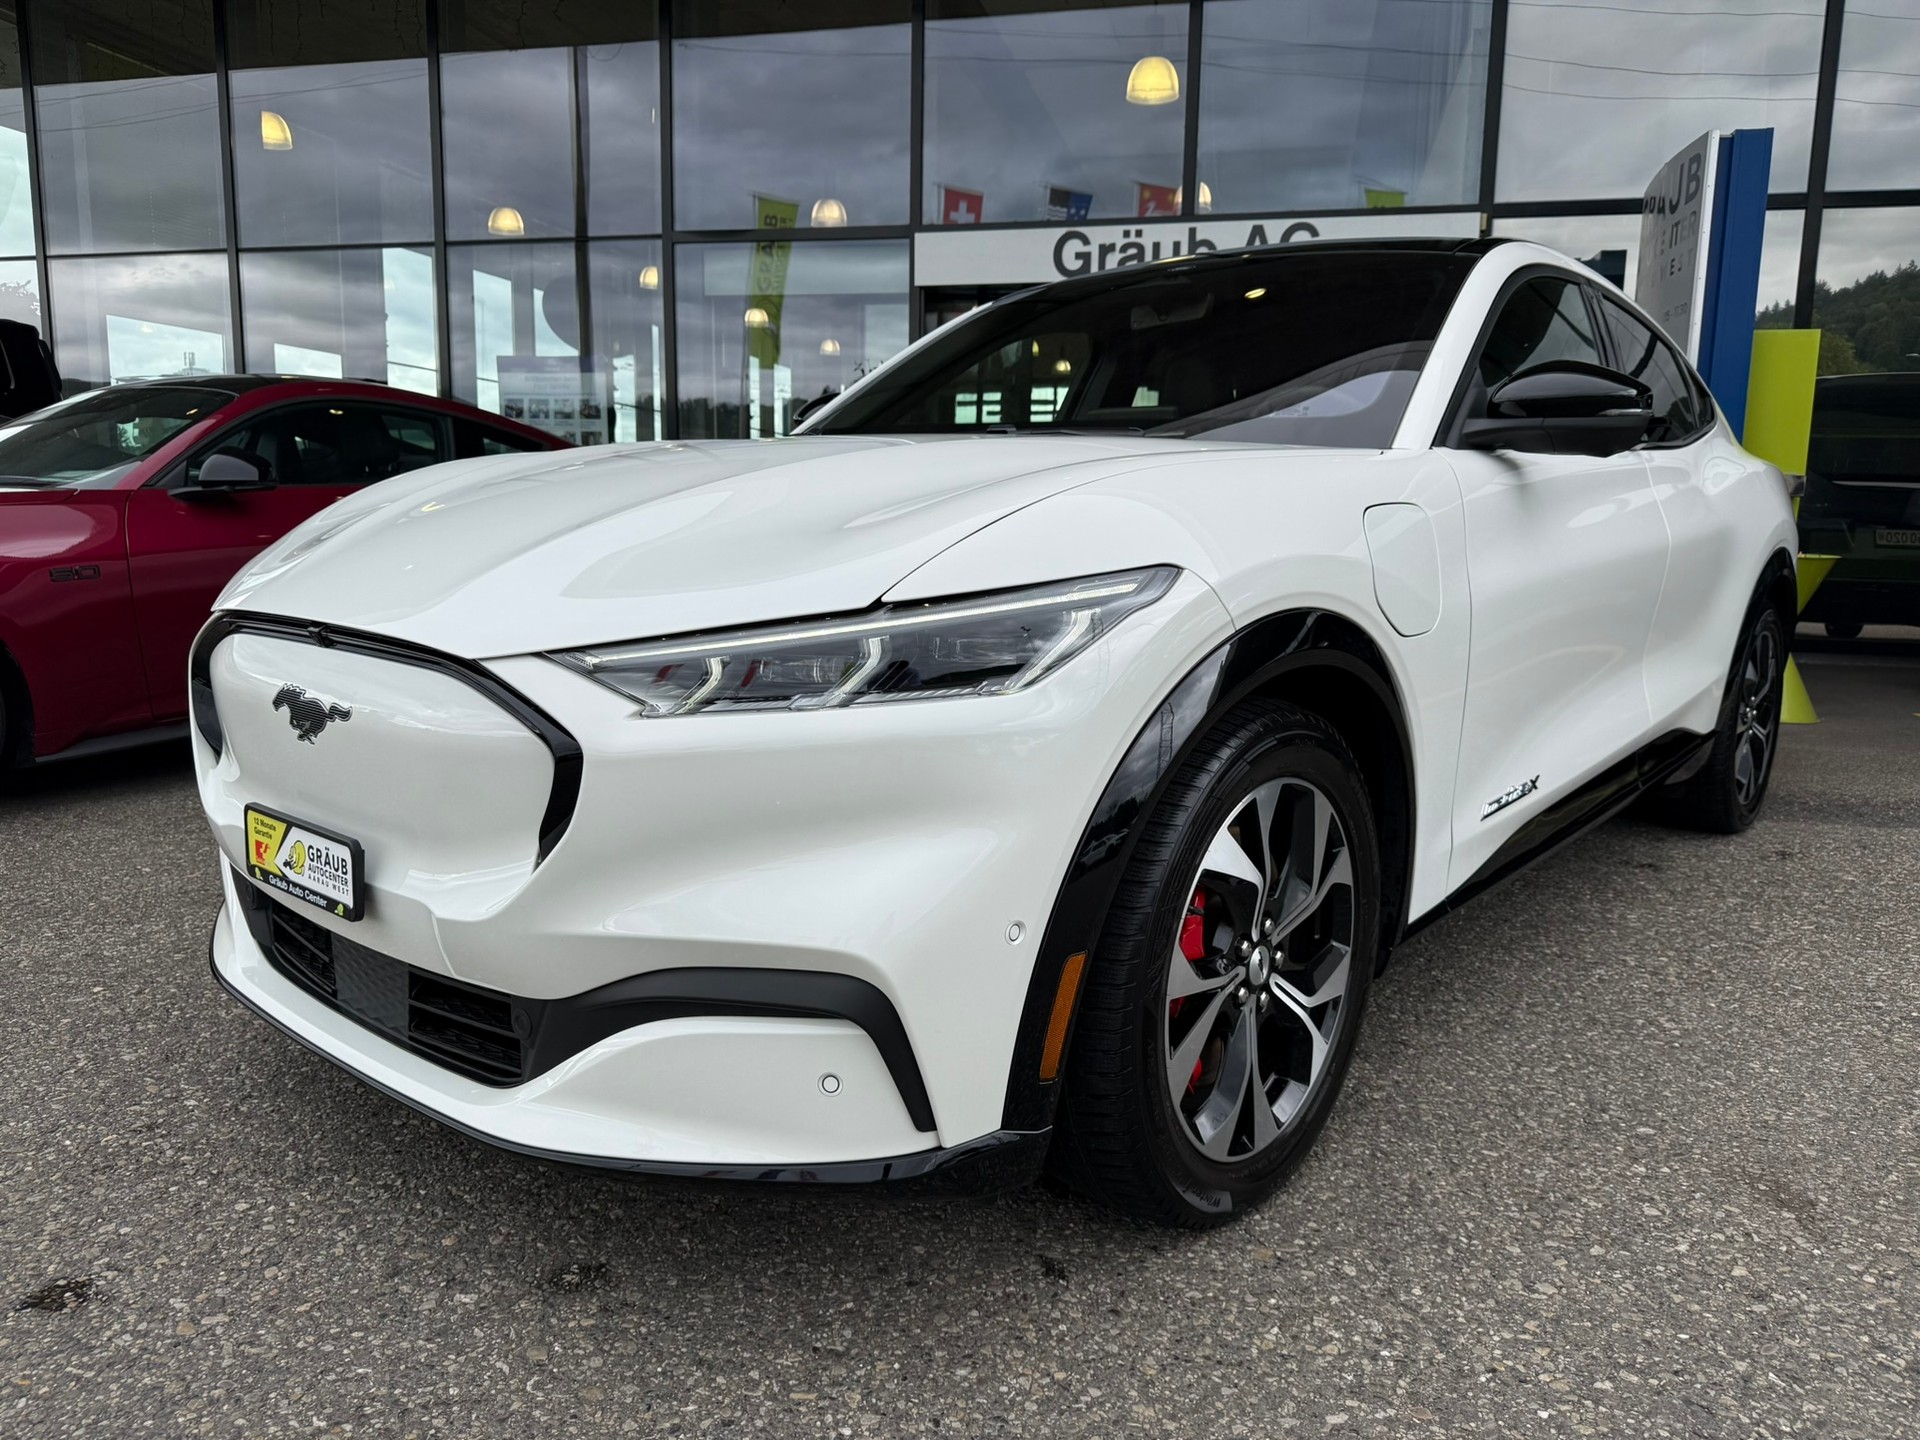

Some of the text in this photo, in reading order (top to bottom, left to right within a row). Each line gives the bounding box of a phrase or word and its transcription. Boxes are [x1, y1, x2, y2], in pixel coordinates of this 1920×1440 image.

[756, 214, 778, 293] GRÄB
[253, 817, 277, 833] 12 Monate
[253, 823, 273, 840] Garantie
[307, 844, 348, 876] GRÄUB
[308, 863, 349, 888] AUTOCENTER
[308, 874, 349, 896] AARAU WEST
[269, 874, 328, 908] Gräub Auto Center
